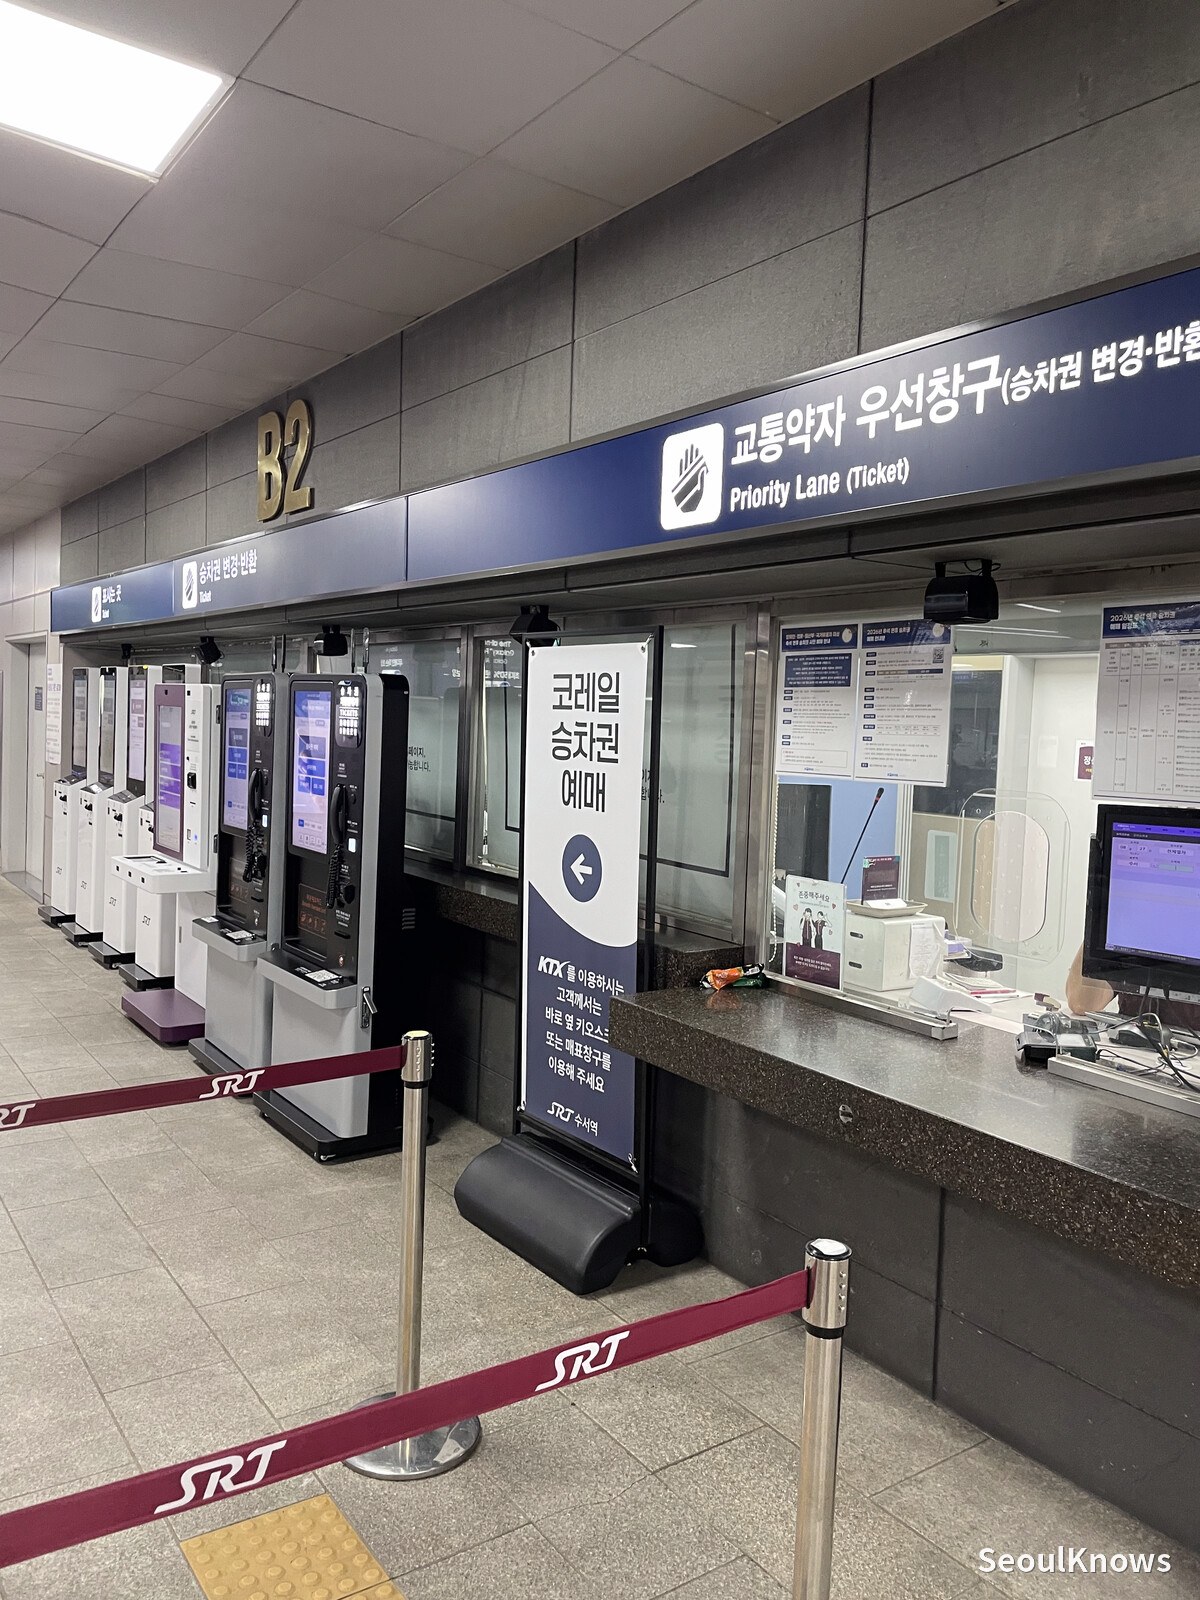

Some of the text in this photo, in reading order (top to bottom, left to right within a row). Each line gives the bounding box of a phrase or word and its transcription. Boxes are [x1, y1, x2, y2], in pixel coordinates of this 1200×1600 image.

[731, 394, 847, 466] 교통약자
[257, 399, 313, 522] B2
[730, 457, 910, 512] Priority Lane (Ticket)
[199, 557, 221, 585] 승차권
[552, 671, 620, 714] 코레일
[551, 721, 619, 764] 승차권
[562, 769, 606, 813] 예매
[537, 955, 625, 996] KTX 를 이용하시는
[545, 1006, 563, 1026] 바로
[564, 1013, 574, 1031] 옆
[556, 986, 603, 1017] 고객께서는
[545, 1030, 612, 1072] 또는 매표창구를
[199, 1069, 265, 1099] SRT
[548, 1056, 605, 1093] 이용해 주세요
[547, 1101, 599, 1137] SRT 수서역
[534, 1330, 630, 1392] SRT
[153, 1439, 287, 1515] SRT
